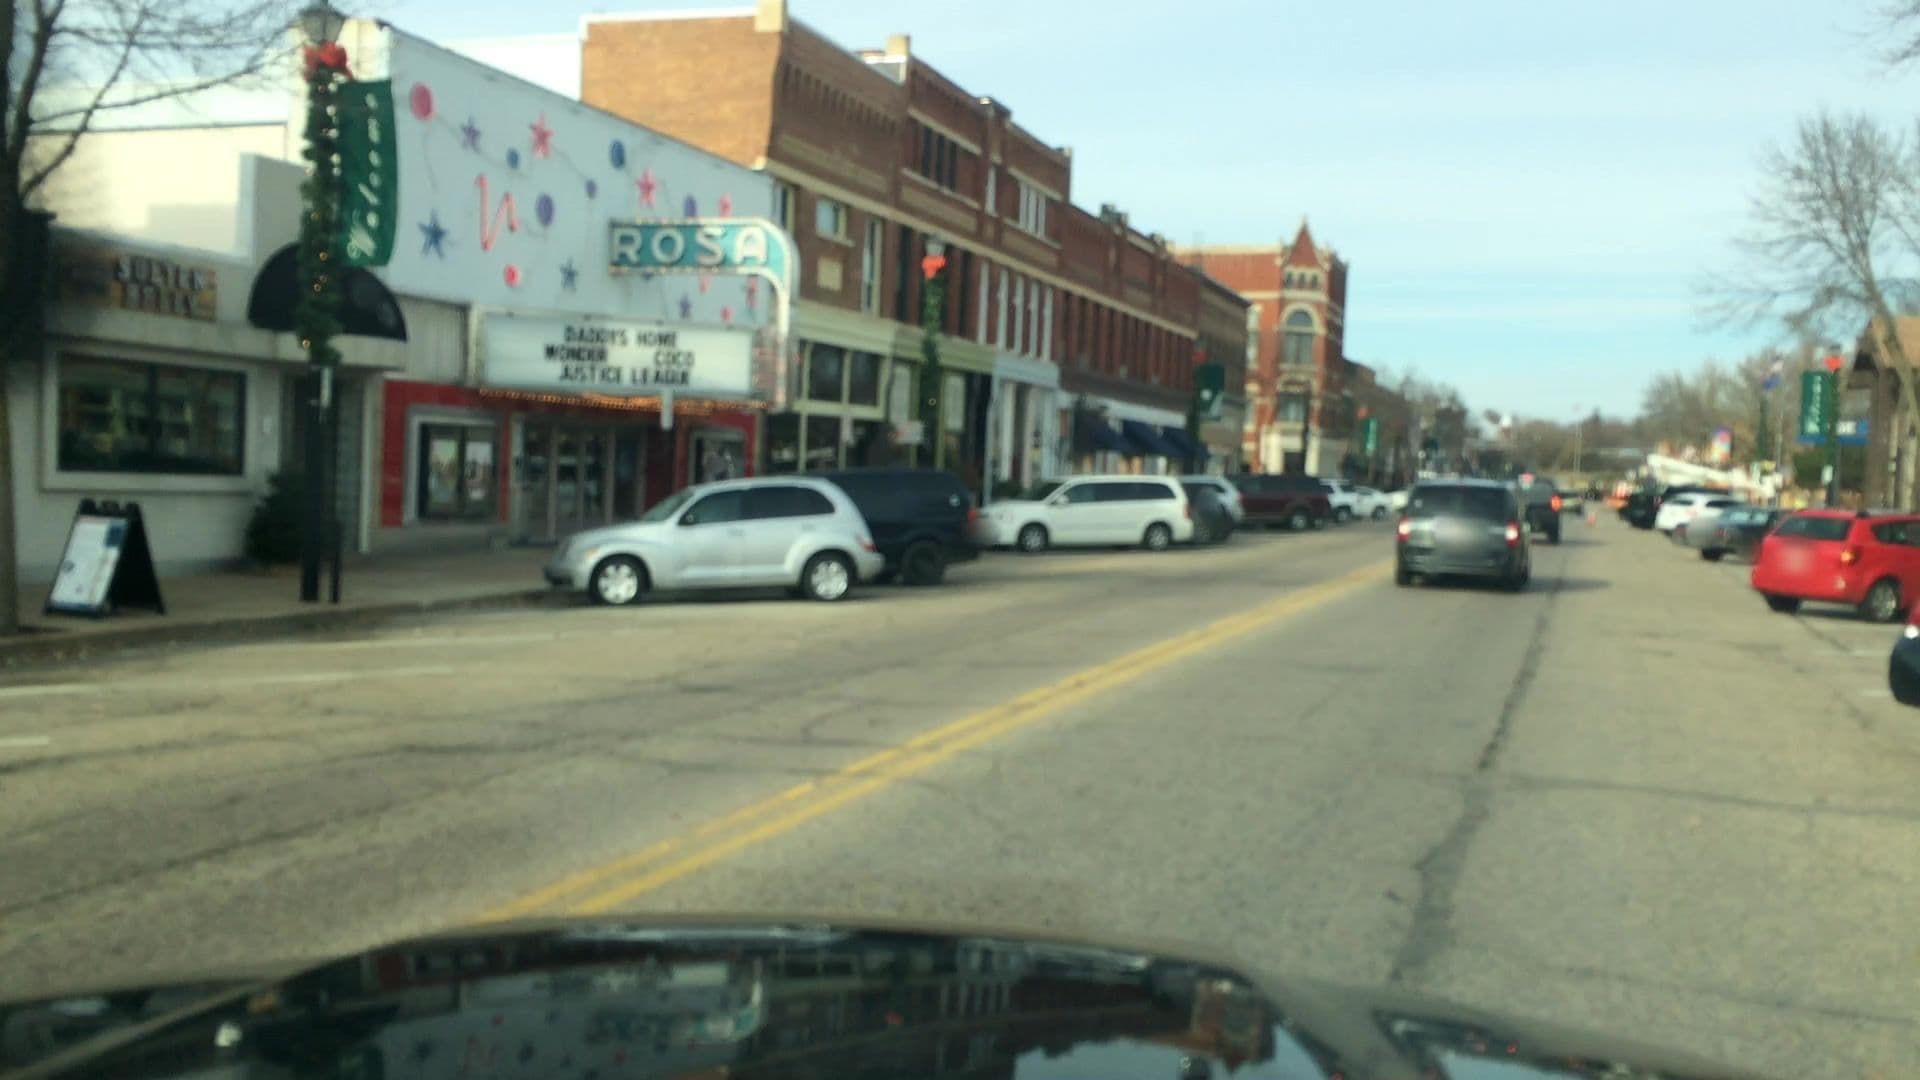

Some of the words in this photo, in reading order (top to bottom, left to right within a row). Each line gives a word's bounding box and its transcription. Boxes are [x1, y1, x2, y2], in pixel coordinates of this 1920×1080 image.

[612, 227, 768, 265] ROSA
[637, 331, 677, 347] HOME
[546, 343, 607, 361] WONDER
[654, 352, 695, 367] COCO
[560, 365, 621, 383] JUSTICE
[632, 367, 689, 385] LEAGUE
